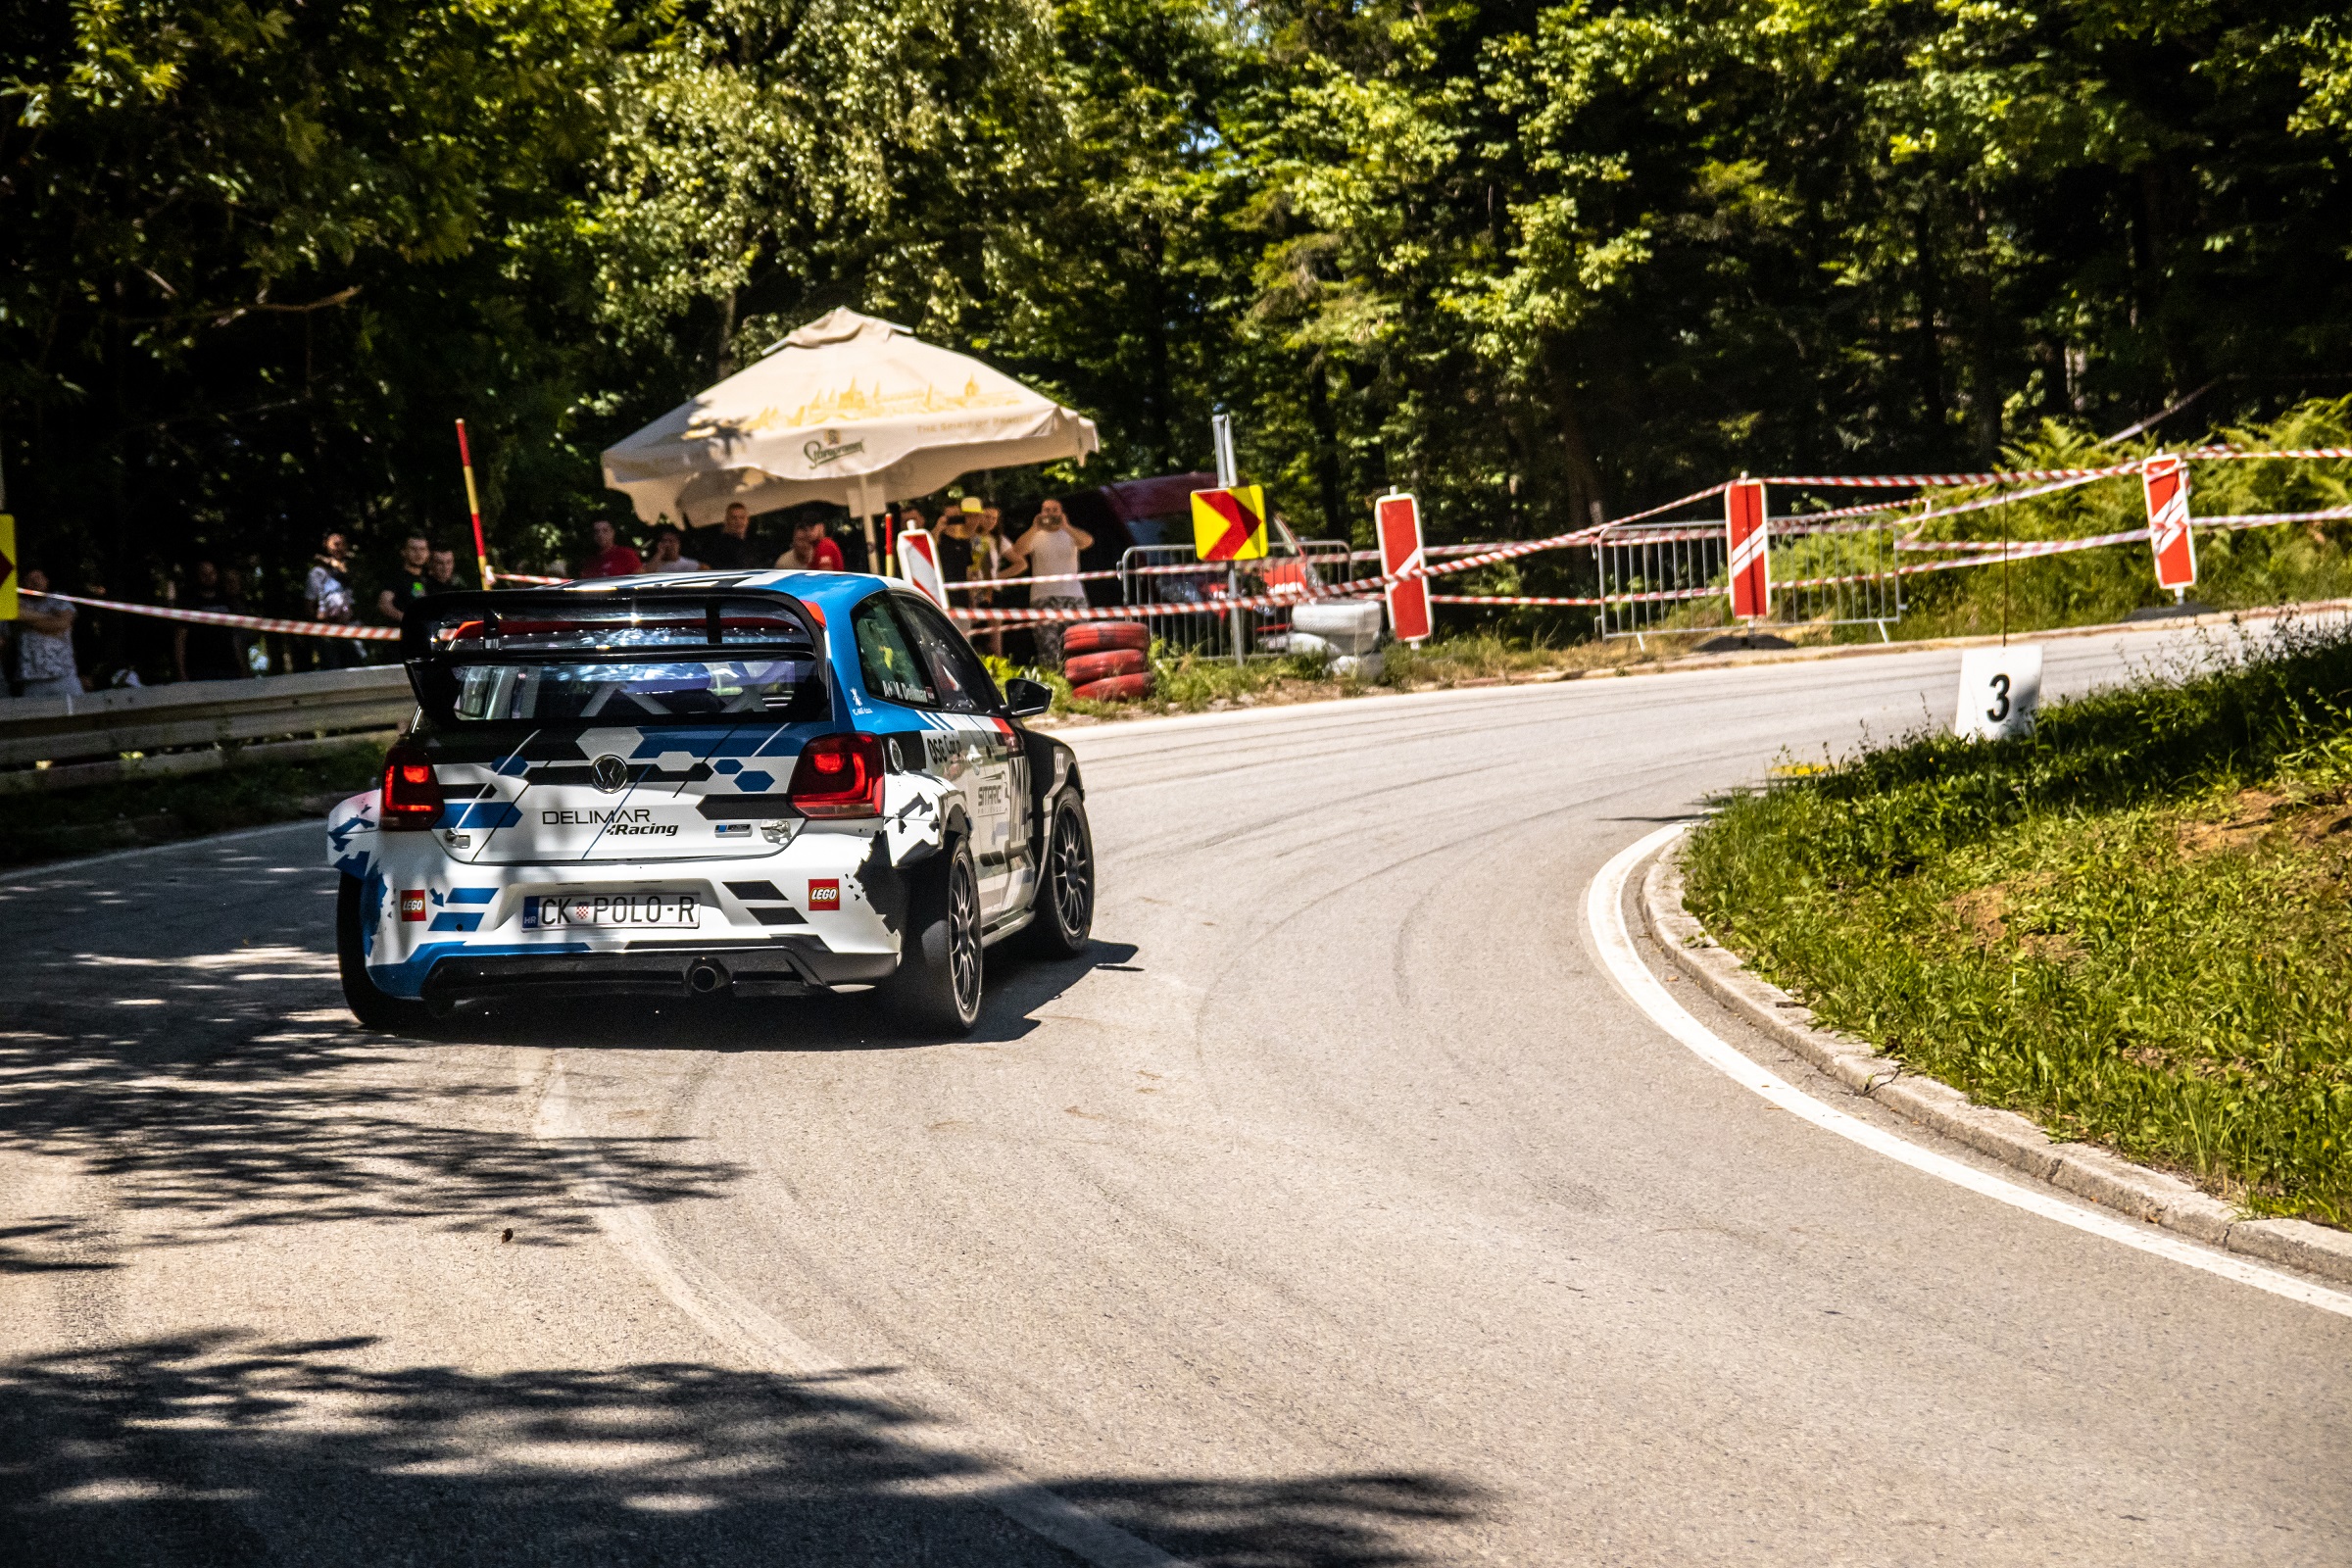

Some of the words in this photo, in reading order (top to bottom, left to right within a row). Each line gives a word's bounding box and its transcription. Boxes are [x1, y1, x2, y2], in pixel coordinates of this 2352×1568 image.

[1986, 673, 2010, 723] 3
[542, 809, 651, 825] DELIMAR
[614, 823, 679, 836] Racing
[811, 888, 837, 901] LEGO
[403, 900, 423, 910] LEGO
[541, 898, 571, 925] CK
[592, 896, 695, 923] POLO-R
[523, 915, 537, 924] HR
